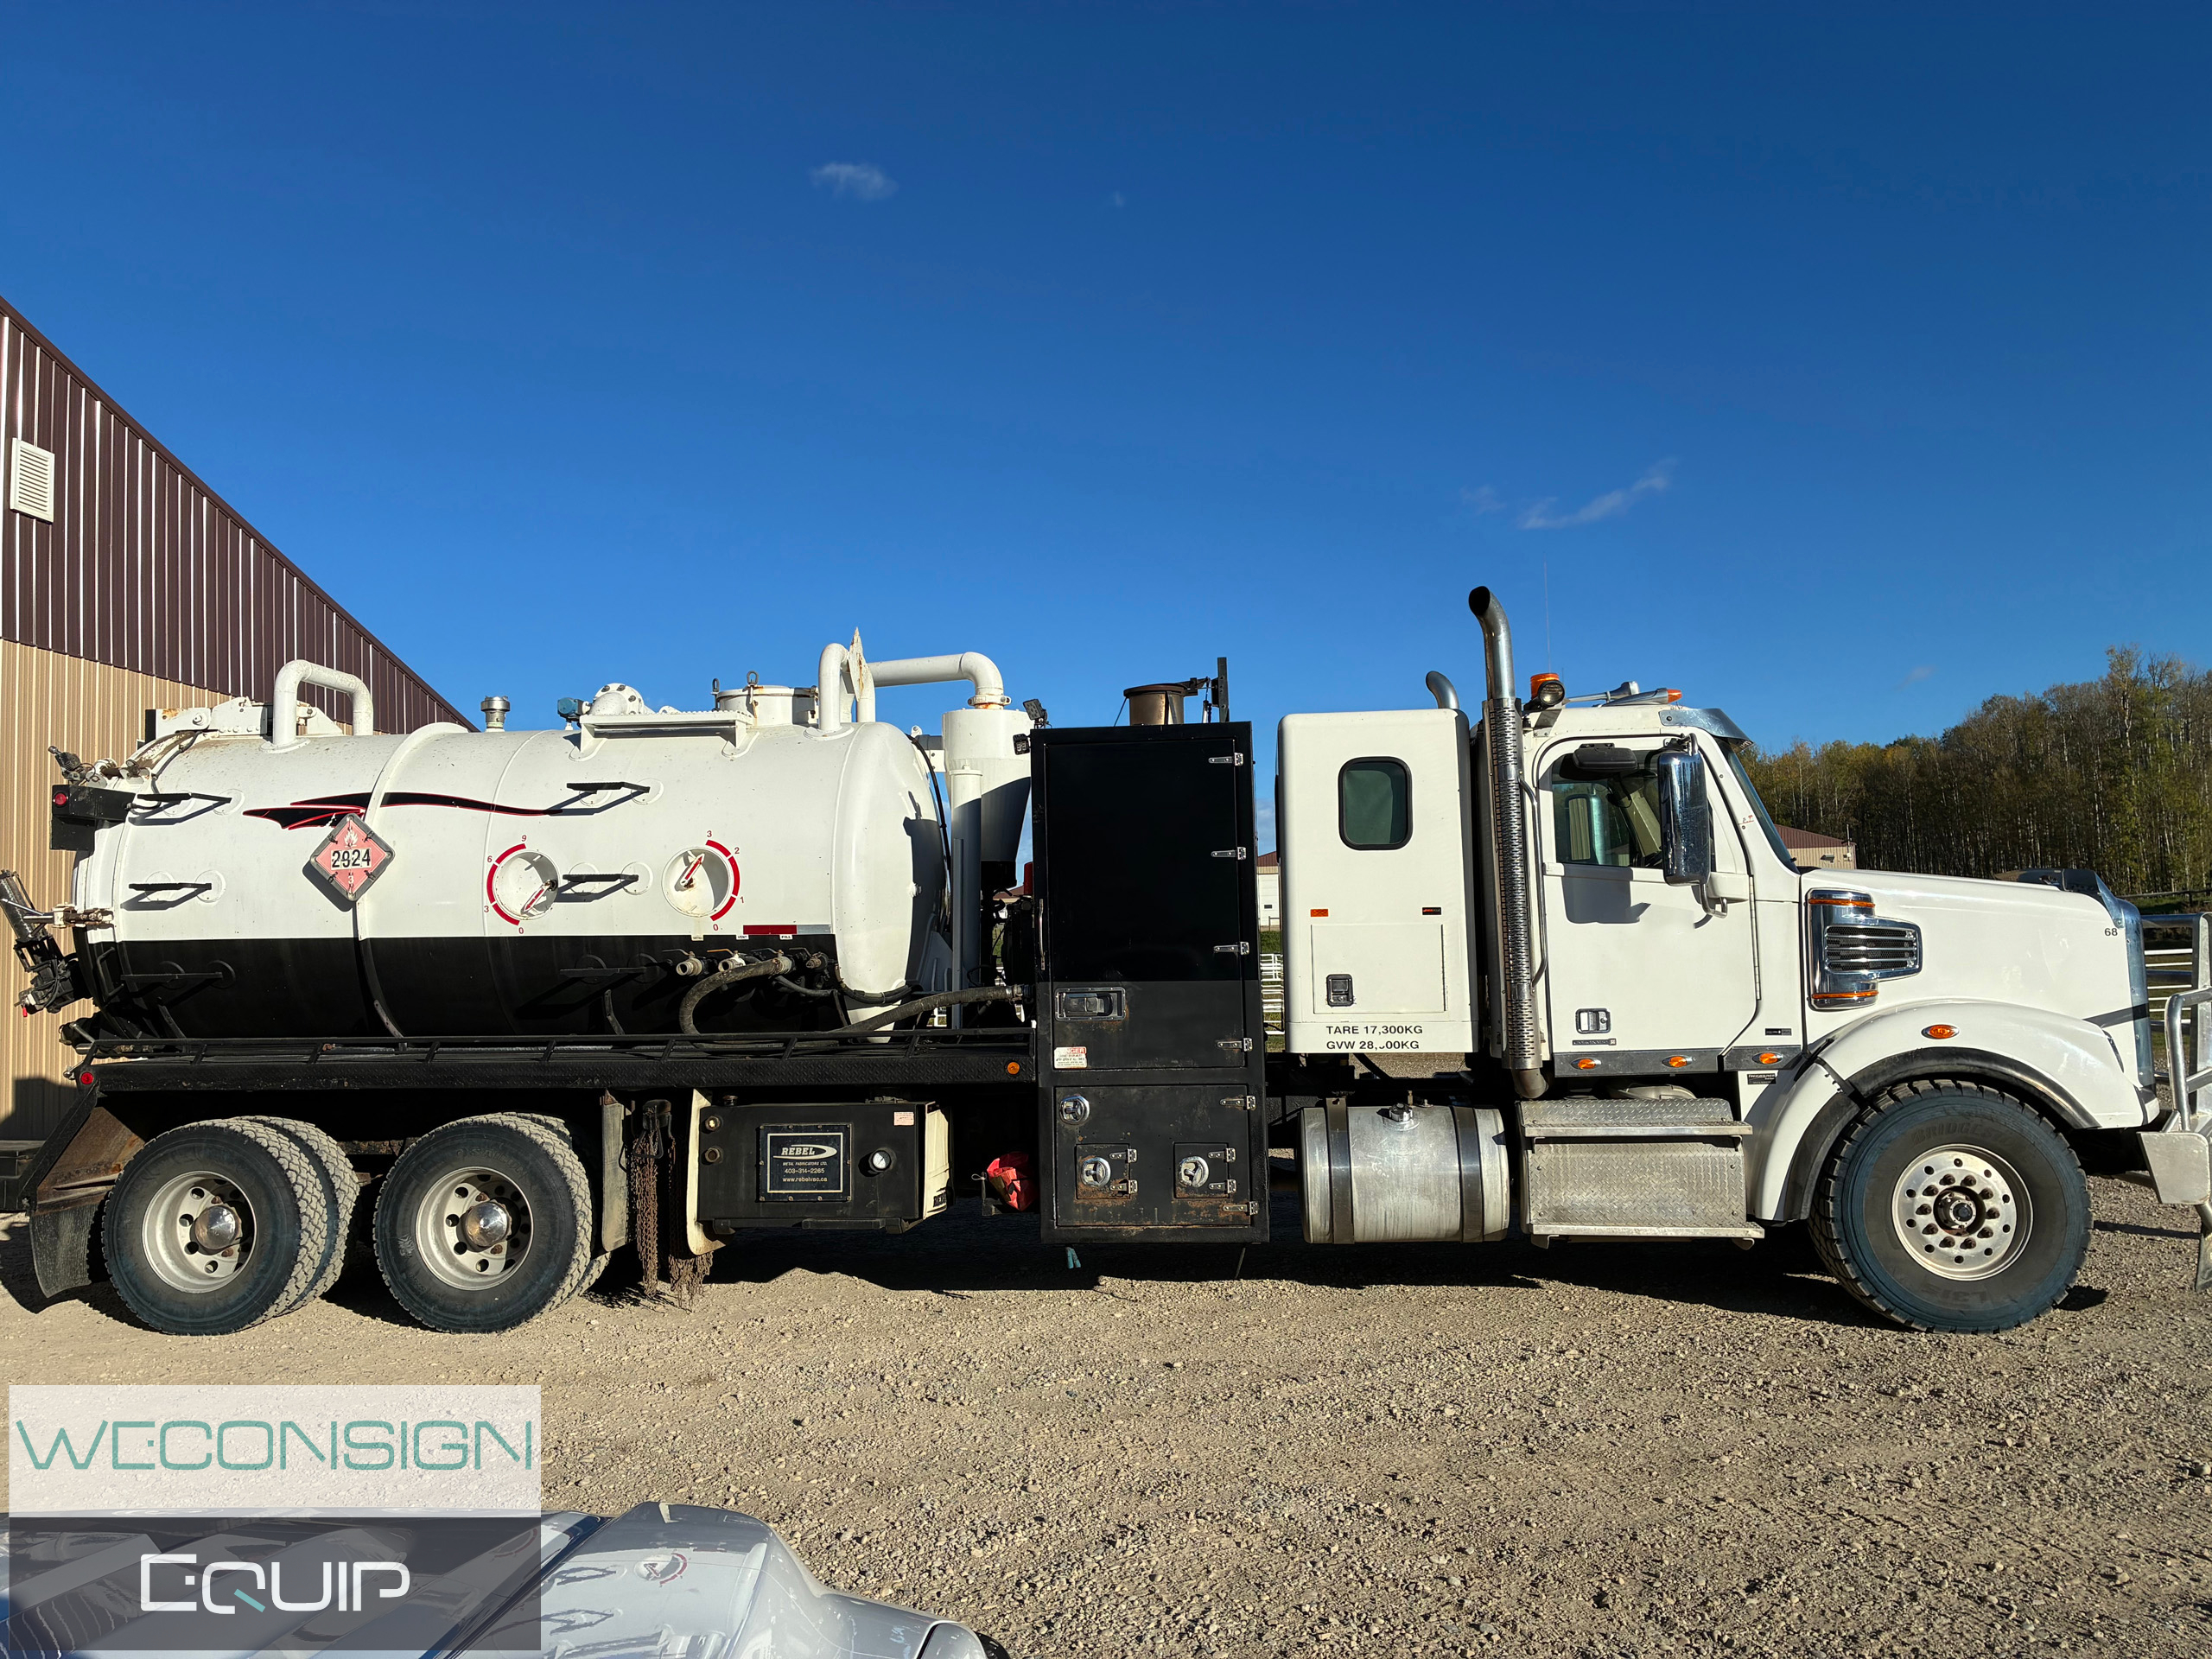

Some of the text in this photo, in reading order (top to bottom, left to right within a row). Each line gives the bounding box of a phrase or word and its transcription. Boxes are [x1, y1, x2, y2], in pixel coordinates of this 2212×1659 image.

[332, 849, 370, 868] 2924
[348, 875, 354, 884] 3
[1325, 1026, 1423, 1036] TARE 17,300KG
[1326, 1040, 1420, 1051] GVW 28,00KG
[781, 1147, 816, 1155] REBEL
